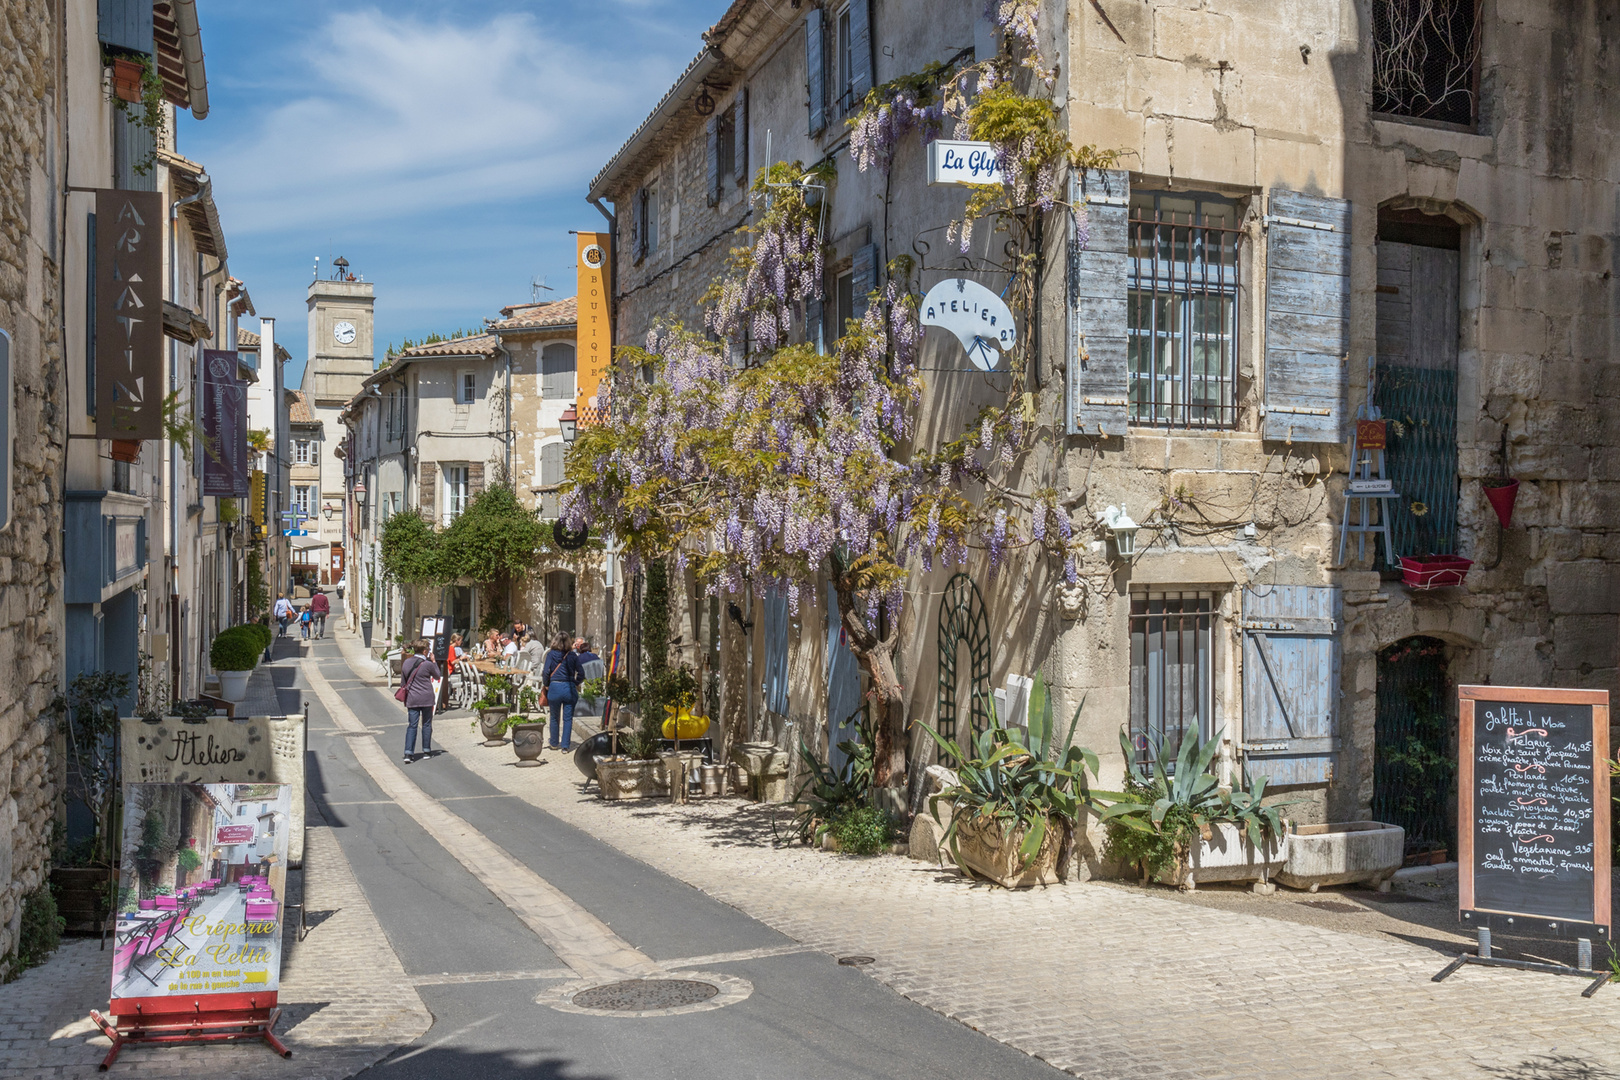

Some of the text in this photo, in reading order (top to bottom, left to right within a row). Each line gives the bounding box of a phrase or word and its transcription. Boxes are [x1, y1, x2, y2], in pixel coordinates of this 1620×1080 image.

[942, 149, 964, 169] La
[590, 275, 598, 377] BOUTIQUE
[927, 300, 1014, 341] ATELIER 27
[212, 383, 226, 409] village
[212, 411, 222, 423] du
[1526, 710, 1537, 727] du
[1541, 716, 1566, 728] Mois
[165, 730, 244, 765] Atelier
[1482, 743, 1502, 754] Noix
[1505, 746, 1515, 755] de
[1478, 755, 1501, 763] crème
[1503, 777, 1535, 791] fromage
[1537, 781, 1548, 790] de
[1508, 801, 1560, 814] Savoyarde
[1537, 821, 1547, 830] de
[181, 914, 278, 942] Crêperie
[155, 942, 273, 968] La Celtie
[179, 970, 184, 979] à
[186, 969, 200, 979] 100
[211, 970, 221, 978] en
[223, 968, 240, 978] haut
[168, 980, 240, 991] de la rue à gauche
